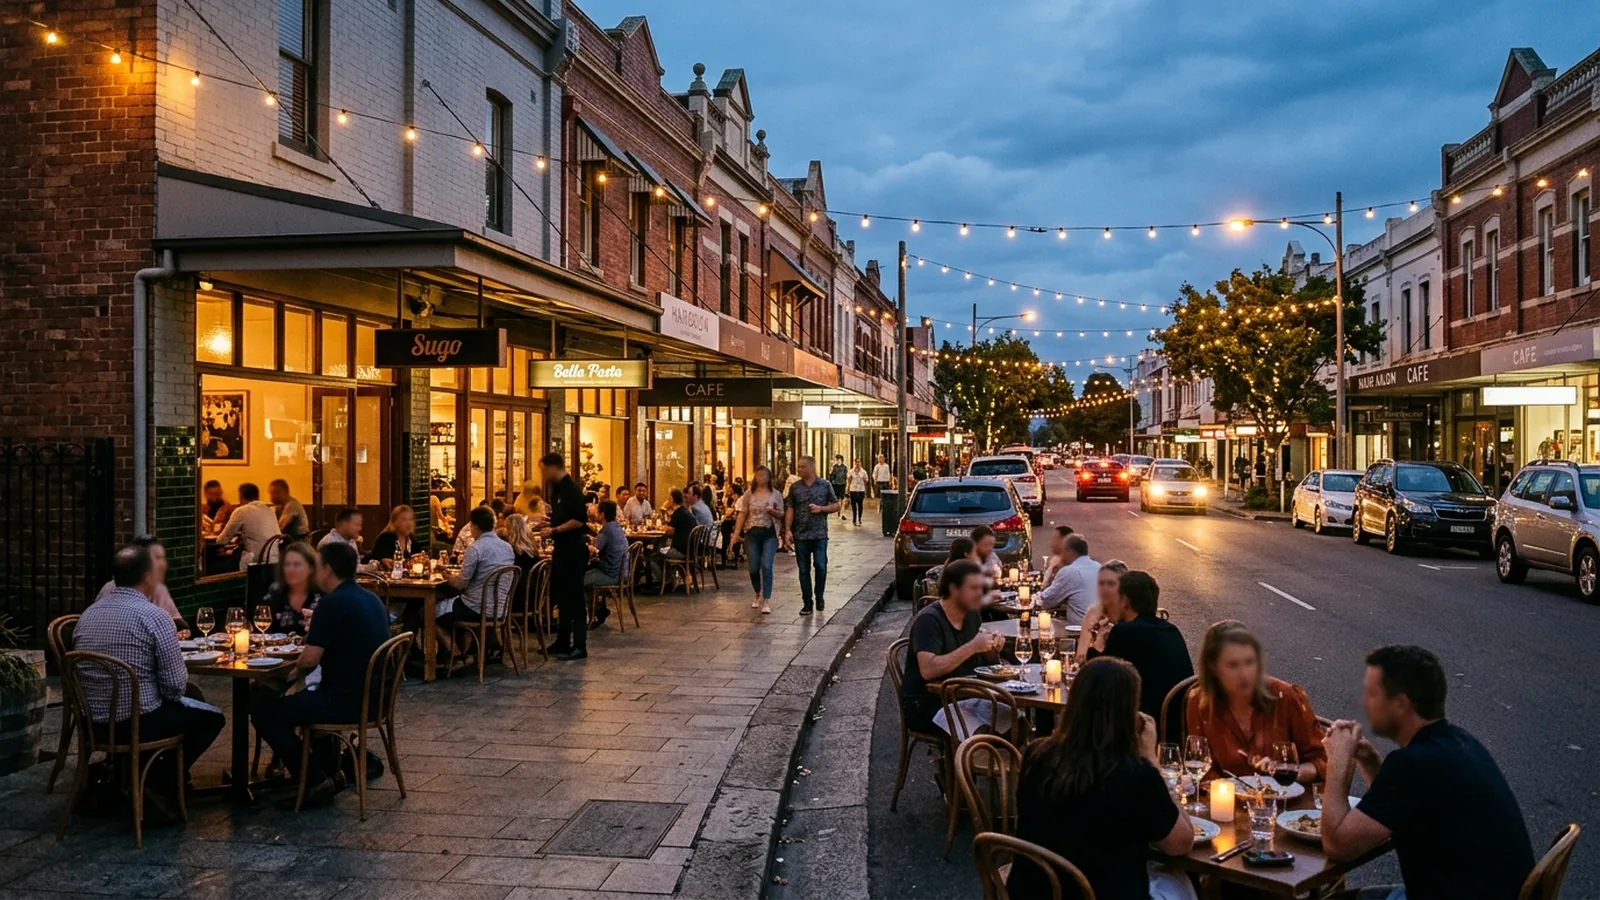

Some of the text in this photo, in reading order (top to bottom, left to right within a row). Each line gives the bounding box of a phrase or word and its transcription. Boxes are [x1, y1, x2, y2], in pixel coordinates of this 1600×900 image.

[411, 333, 463, 363] Sugo
[1513, 345, 1537, 365] CAFE
[1407, 364, 1429, 383] CAFE
[685, 383, 724, 396] CAFE
